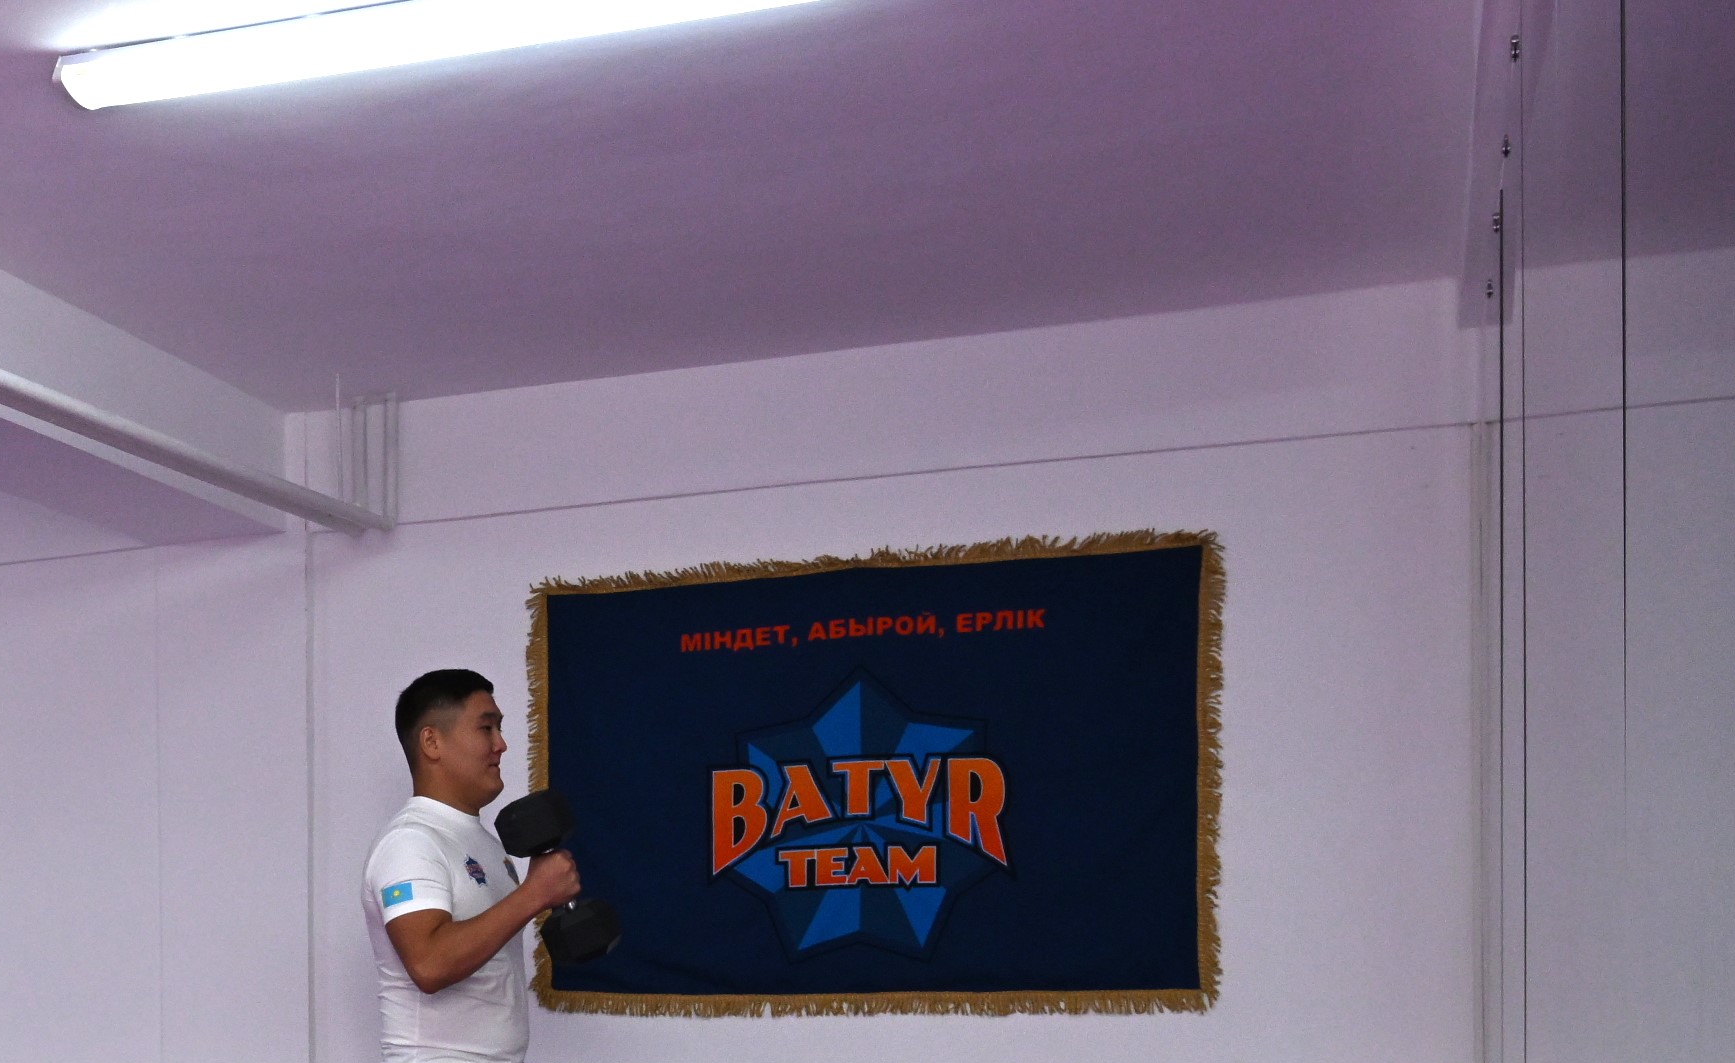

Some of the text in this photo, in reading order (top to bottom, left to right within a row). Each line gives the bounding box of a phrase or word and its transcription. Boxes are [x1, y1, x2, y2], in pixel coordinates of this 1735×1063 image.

[680, 609, 1046, 652] МІНДЕТ, АБЫРОЙ, ЕРЛІК
[712, 757, 1008, 876] BATYR
[778, 845, 937, 888] TEAM
